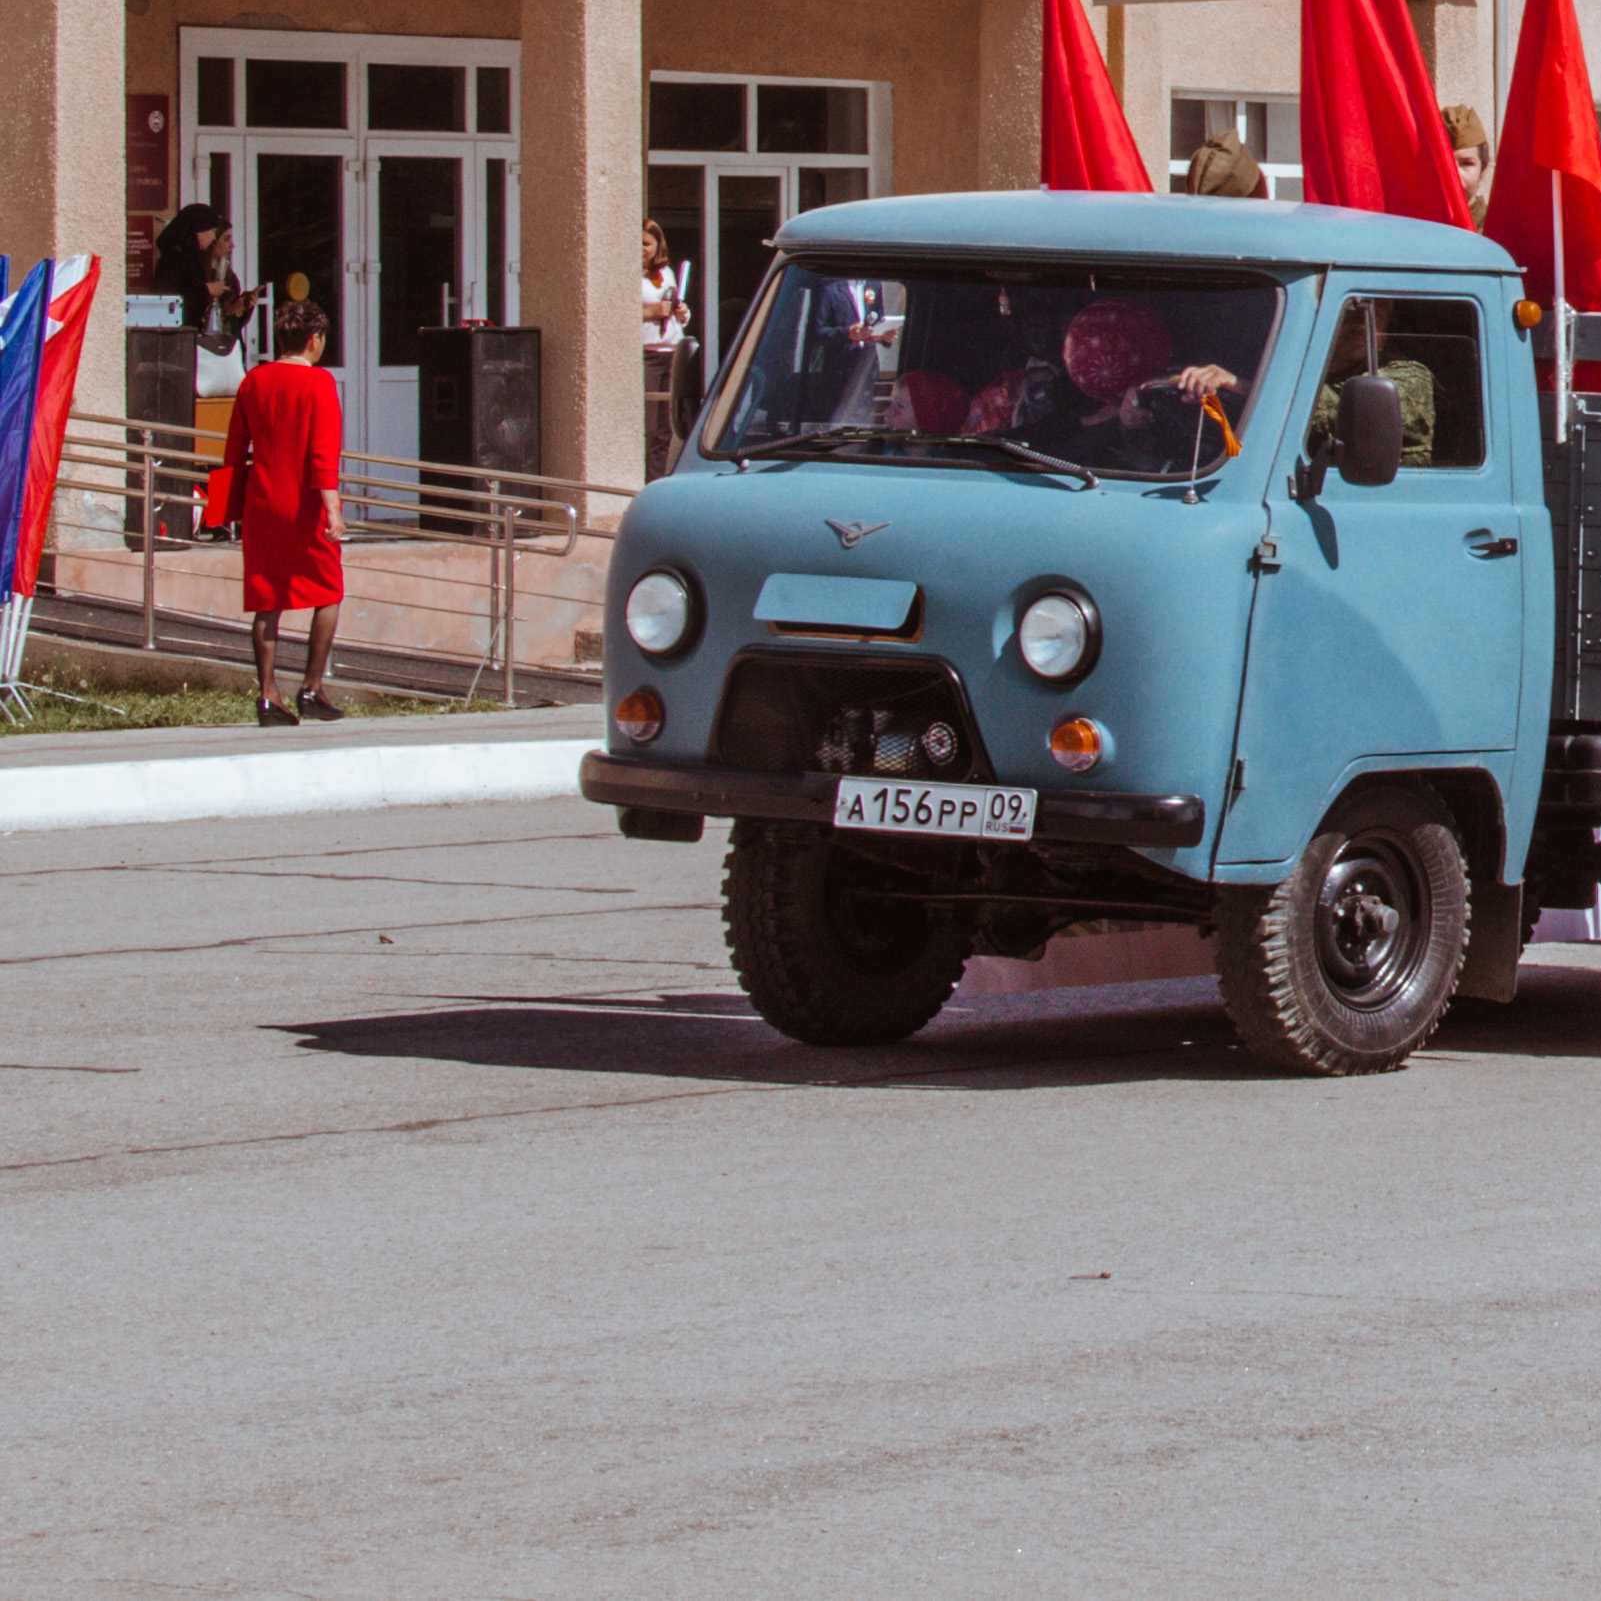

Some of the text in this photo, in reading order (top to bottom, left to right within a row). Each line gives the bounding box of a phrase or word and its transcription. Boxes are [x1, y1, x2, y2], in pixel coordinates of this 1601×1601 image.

[847, 787, 1023, 828] А156РР 09
[985, 821, 1009, 833] RUS
